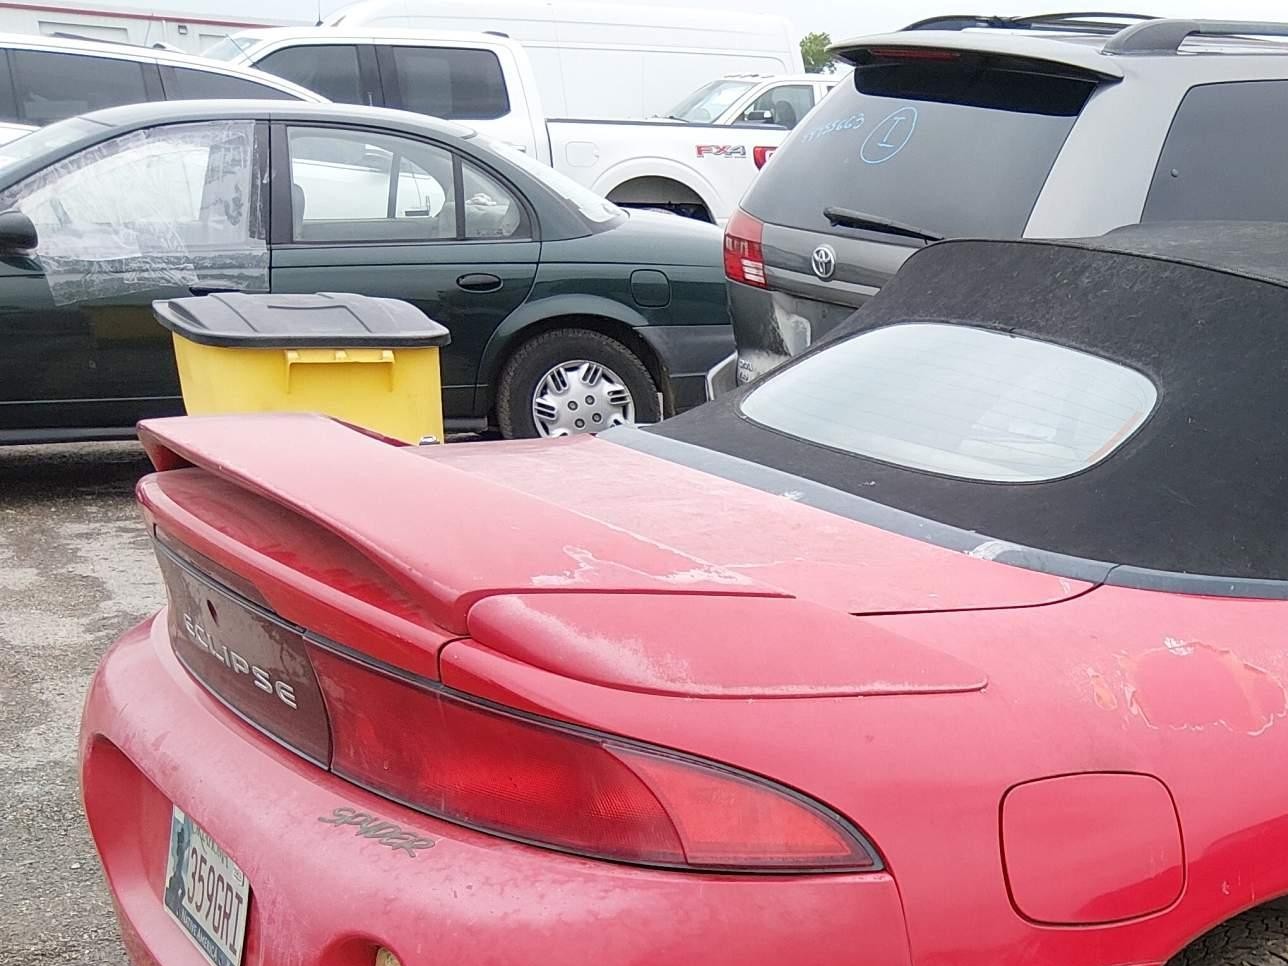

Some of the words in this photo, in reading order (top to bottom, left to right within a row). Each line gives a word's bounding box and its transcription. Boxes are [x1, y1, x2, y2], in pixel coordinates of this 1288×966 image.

[696, 145, 746, 156] FX4
[184, 613, 298, 710] ECLIPSE
[187, 847, 243, 955] 359GRI
